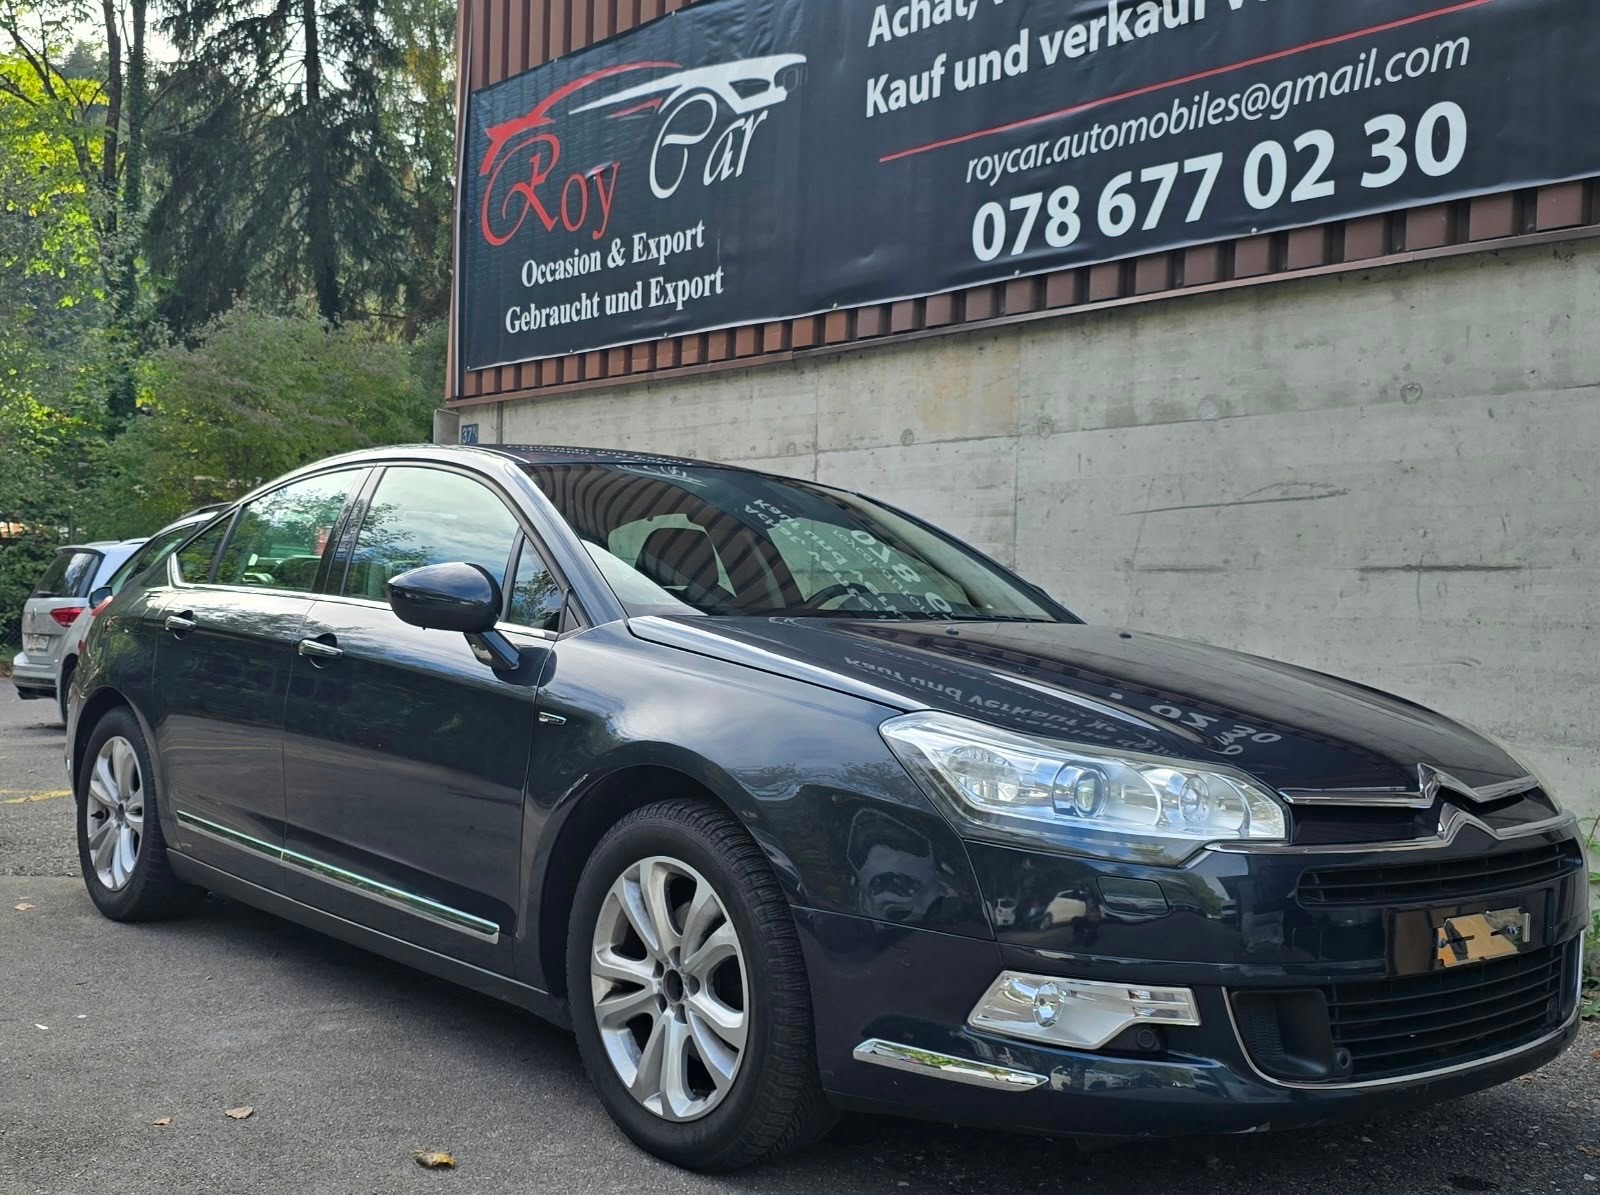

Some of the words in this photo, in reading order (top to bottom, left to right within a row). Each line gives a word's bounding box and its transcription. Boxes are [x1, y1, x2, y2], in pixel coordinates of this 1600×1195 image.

[866, 53, 947, 118] Kauf
[954, 28, 1029, 92] und
[965, 37, 1470, 187] roycar.automobiles@gmail.com
[482, 133, 620, 246] Roy
[649, 93, 768, 199] Car
[972, 186, 1081, 262] 078
[1097, 152, 1224, 238] 677
[1243, 129, 1335, 210] 02
[1360, 101, 1467, 188] 30
[505, 292, 601, 334] Gebraucht
[605, 281, 642, 315] und
[649, 266, 724, 310] Export
[521, 248, 602, 288] Occasion
[607, 238, 626, 268] &
[632, 220, 705, 265] Export
